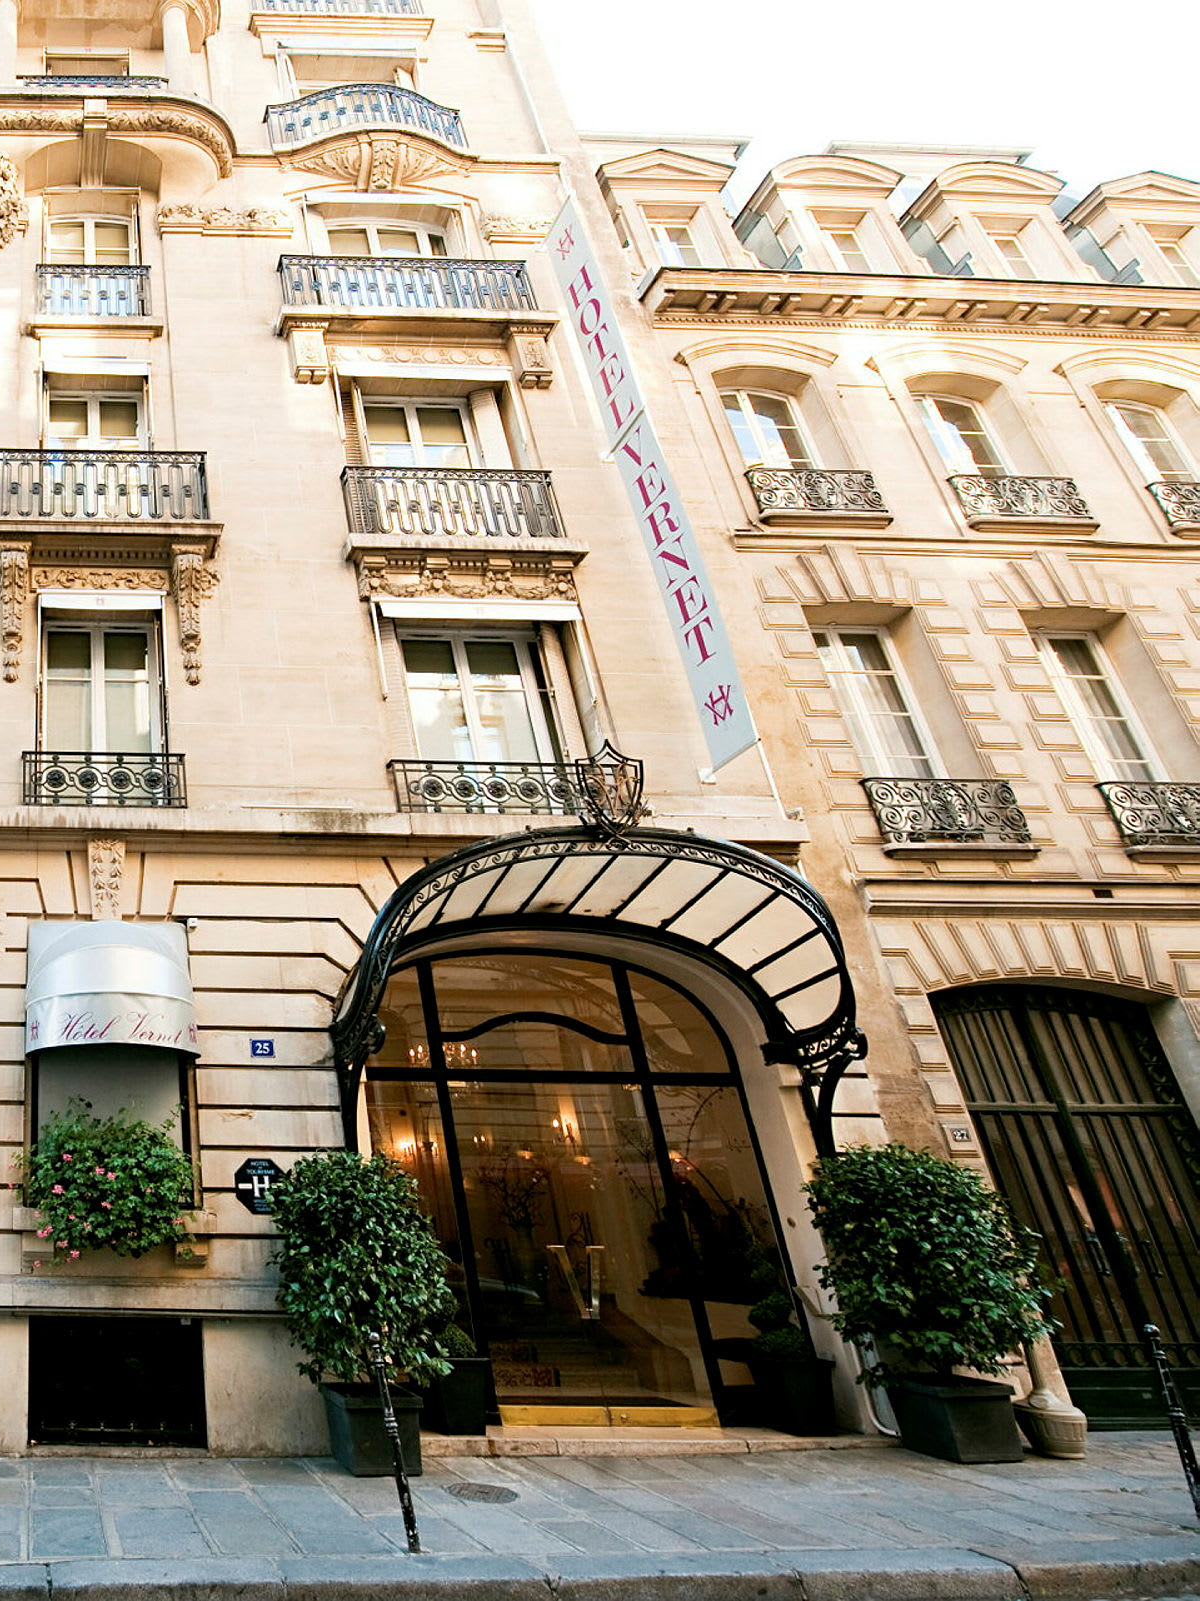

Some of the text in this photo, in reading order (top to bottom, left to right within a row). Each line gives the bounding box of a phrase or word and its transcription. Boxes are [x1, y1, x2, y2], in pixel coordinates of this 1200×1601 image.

[569, 265, 714, 668] HOTEL VERNET
[255, 1042, 270, 1054] 25
